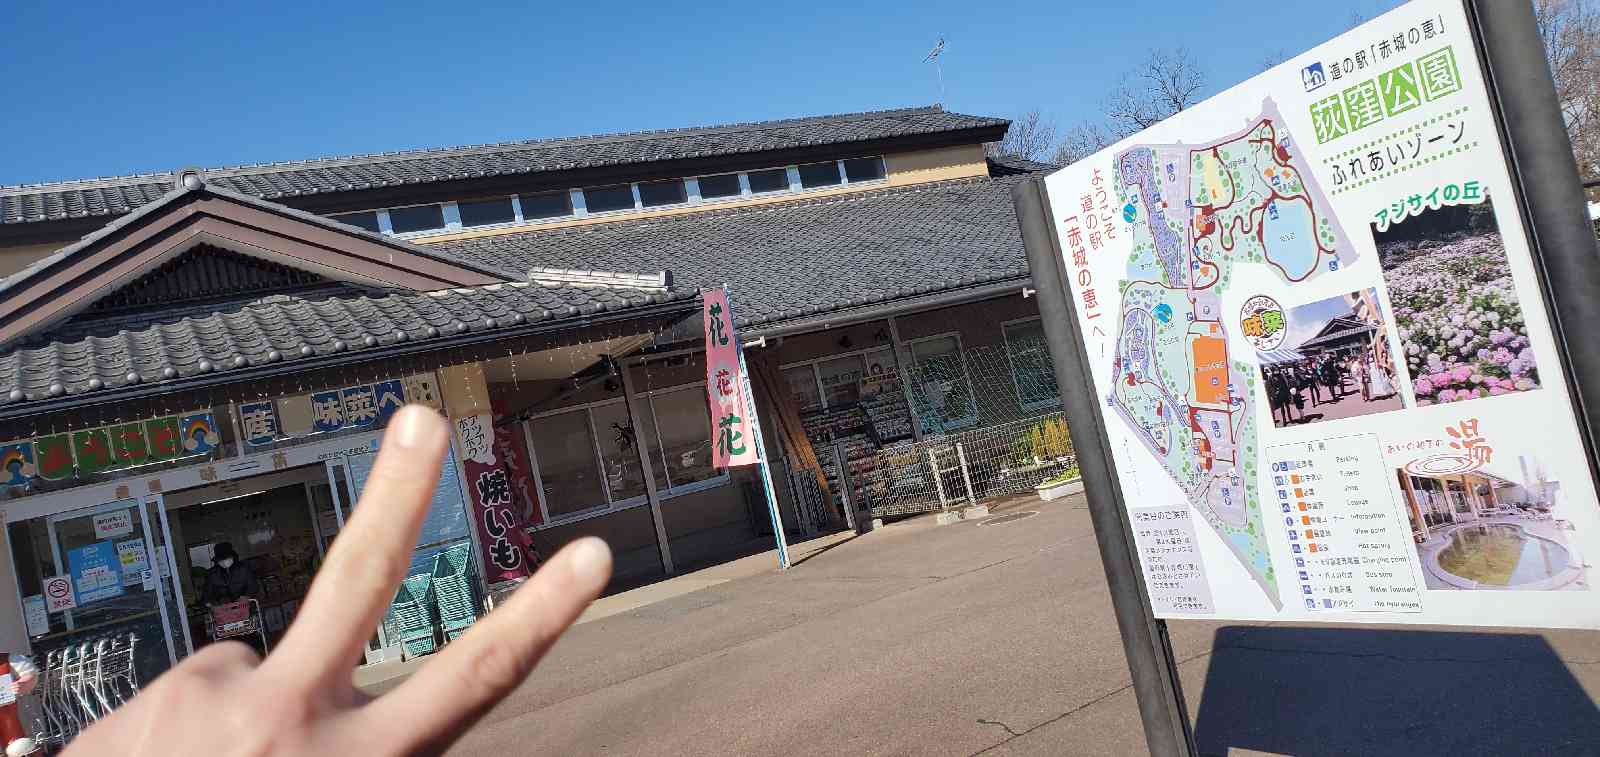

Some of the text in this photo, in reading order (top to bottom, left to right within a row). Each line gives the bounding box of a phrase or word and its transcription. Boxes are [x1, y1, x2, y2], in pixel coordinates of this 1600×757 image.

[1329, 15, 1446, 81] 道の駅「赤城の恵」
[1309, 45, 1463, 144] 荻窪公園
[1332, 121, 1465, 186] ふれあいゾーン
[1080, 195, 1104, 250] 道の駅
[1091, 167, 1117, 240] ようこそ
[1374, 180, 1481, 228] アジサイの丘
[1445, 418, 1493, 464] 湯
[475, 468, 522, 571] 焼いも
